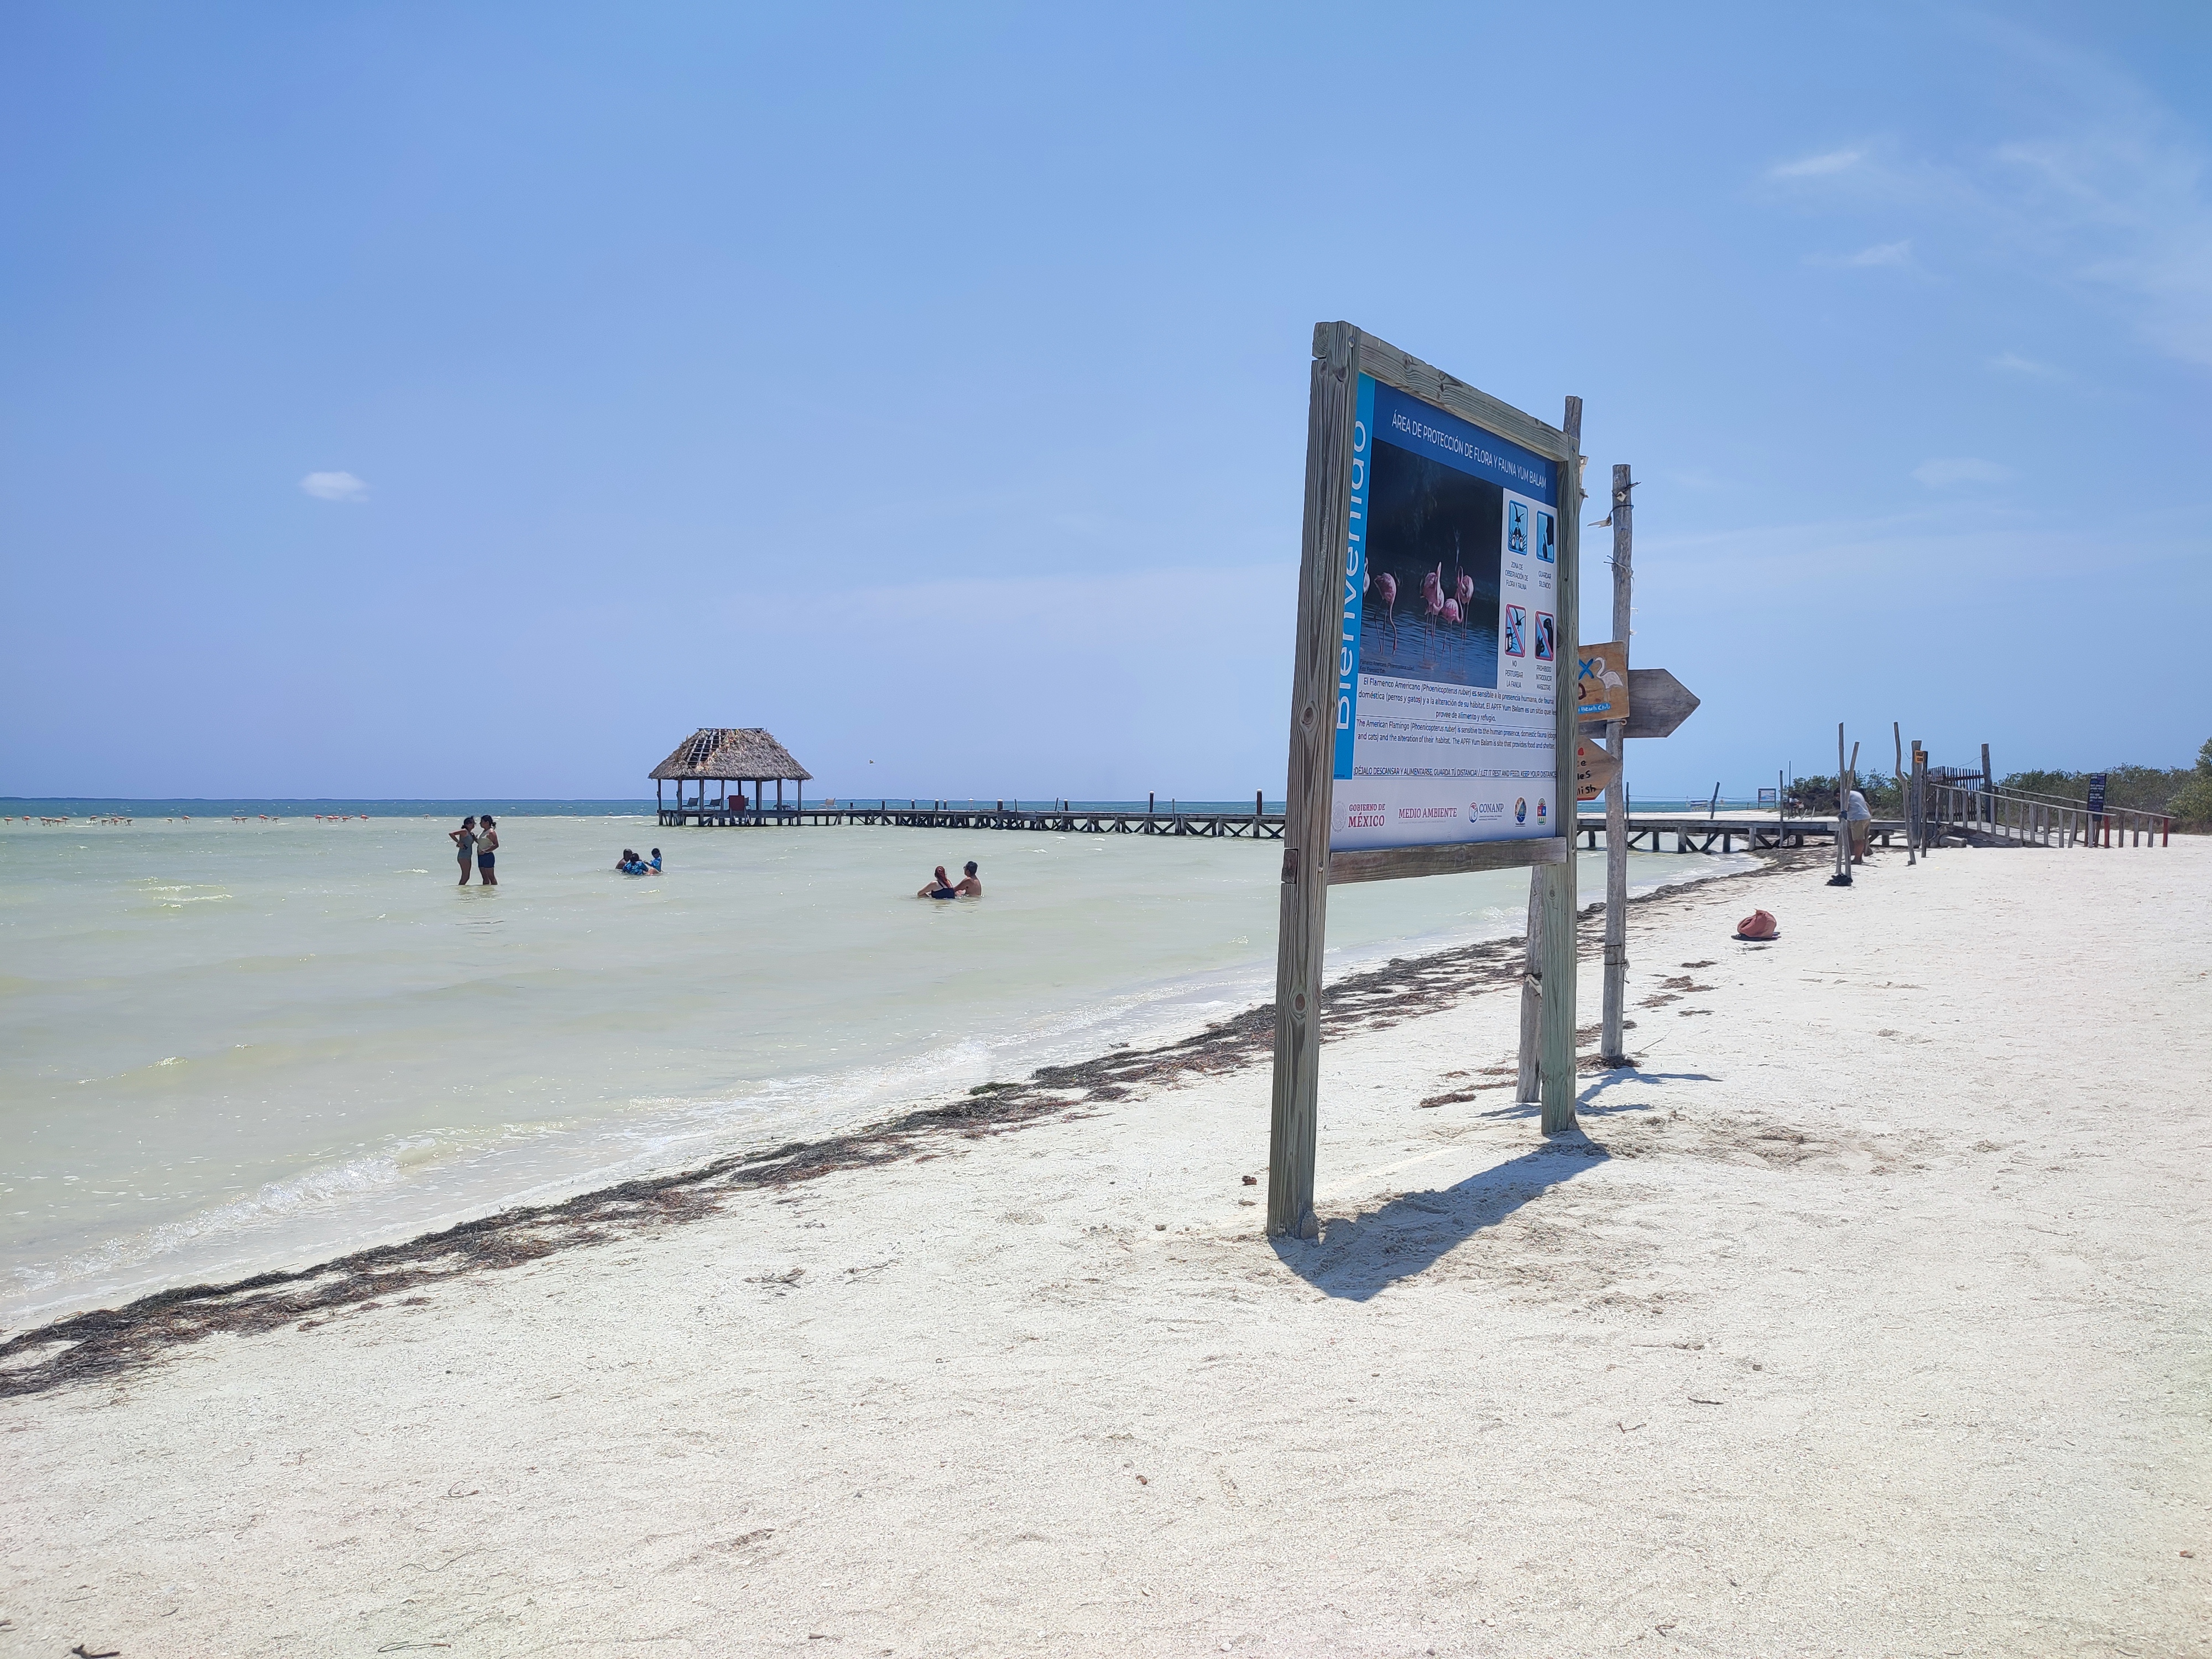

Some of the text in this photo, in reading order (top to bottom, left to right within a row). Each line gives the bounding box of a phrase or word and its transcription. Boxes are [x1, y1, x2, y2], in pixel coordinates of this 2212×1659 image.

[1392, 409, 1547, 489] ÁREA DE PROTECCIÓN DE FLORA Y FAUNA YUM BALAM
[1370, 678, 1394, 687] Flamenco
[1395, 681, 1420, 691] Americano
[1458, 688, 1471, 697] ruber)
[1521, 695, 1538, 703] humana,
[1358, 690, 1385, 700] doméstica
[1386, 692, 1402, 702] (perros
[1408, 696, 1422, 705] gatos)
[1435, 697, 1457, 706] alteración
[1481, 714, 1496, 722] refugio.
[1366, 719, 1387, 728] American
[1389, 721, 1409, 731] Flamingo
[1410, 722, 1444, 733] (Phoenicopterus
[1444, 724, 1456, 734] ruber)
[1368, 733, 1379, 742] cats)
[1349, 804, 1376, 812] GOBIERNO
[1399, 807, 1457, 818] MEDIO AMBIENTE
[1479, 803, 1504, 813] CONANP
[1348, 812, 1385, 828] MÉXICO
